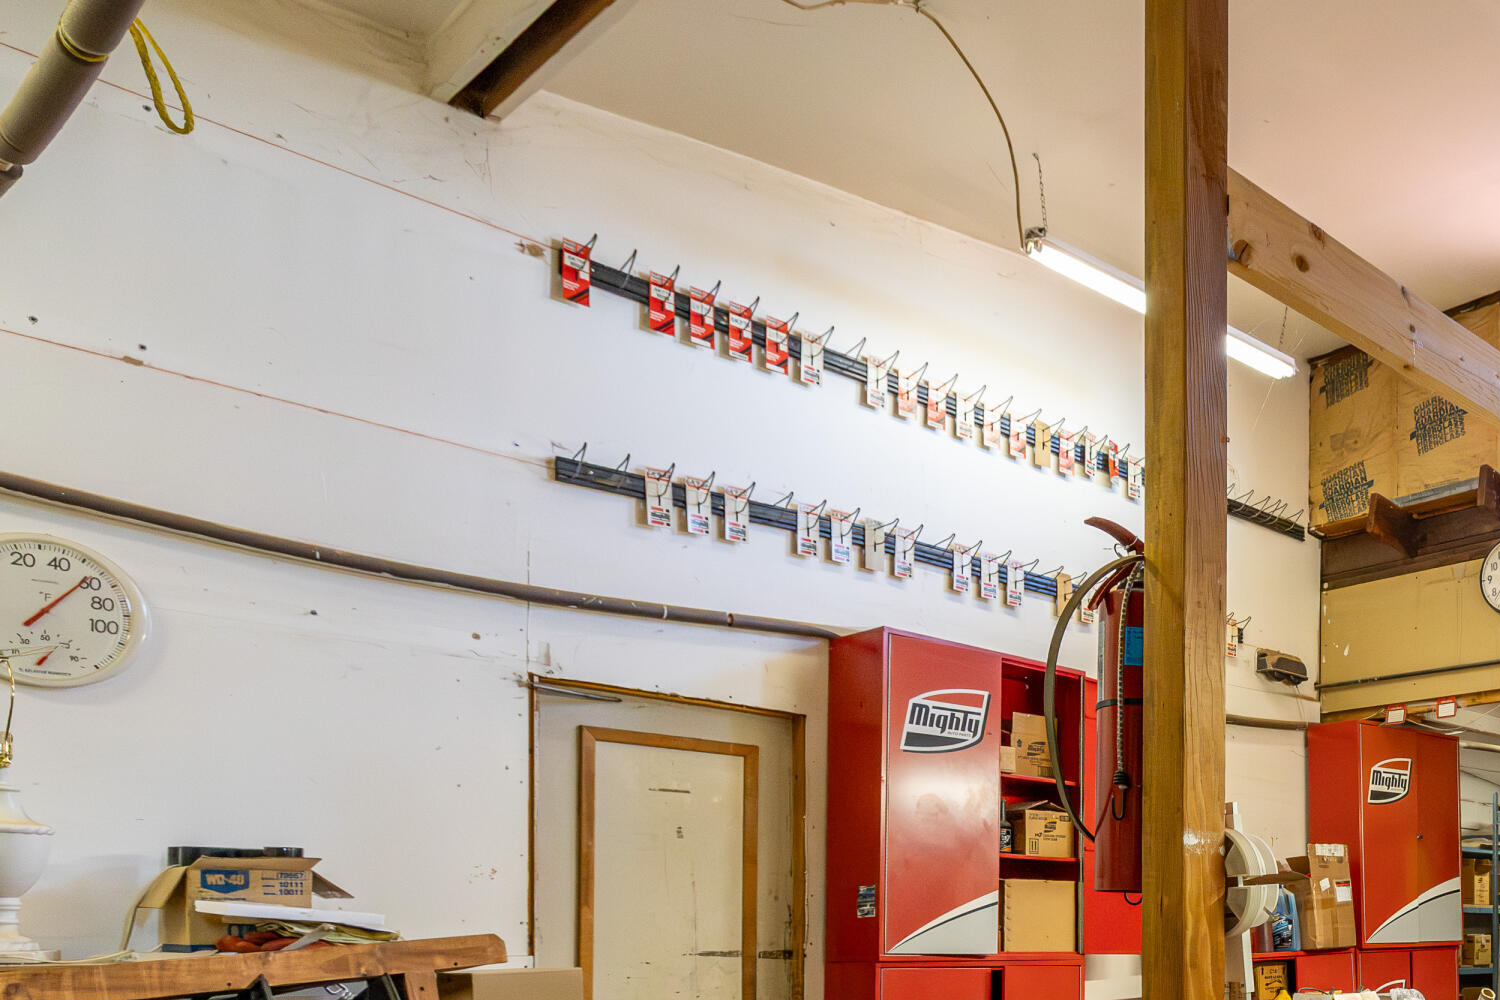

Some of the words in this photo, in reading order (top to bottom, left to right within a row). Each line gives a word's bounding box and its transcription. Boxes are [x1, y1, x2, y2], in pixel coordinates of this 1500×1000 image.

[10, 551, 36, 568] 20
[47, 557, 71, 571] 40
[1490, 561, 1498, 572] 10
[1487, 574, 1493, 584] 9
[1491, 587, 1497, 597] 8
[90, 596, 115, 611] 80
[89, 618, 119, 635] 100
[908, 702, 981, 739] Mighty
[1371, 769, 1408, 793] Mighty
